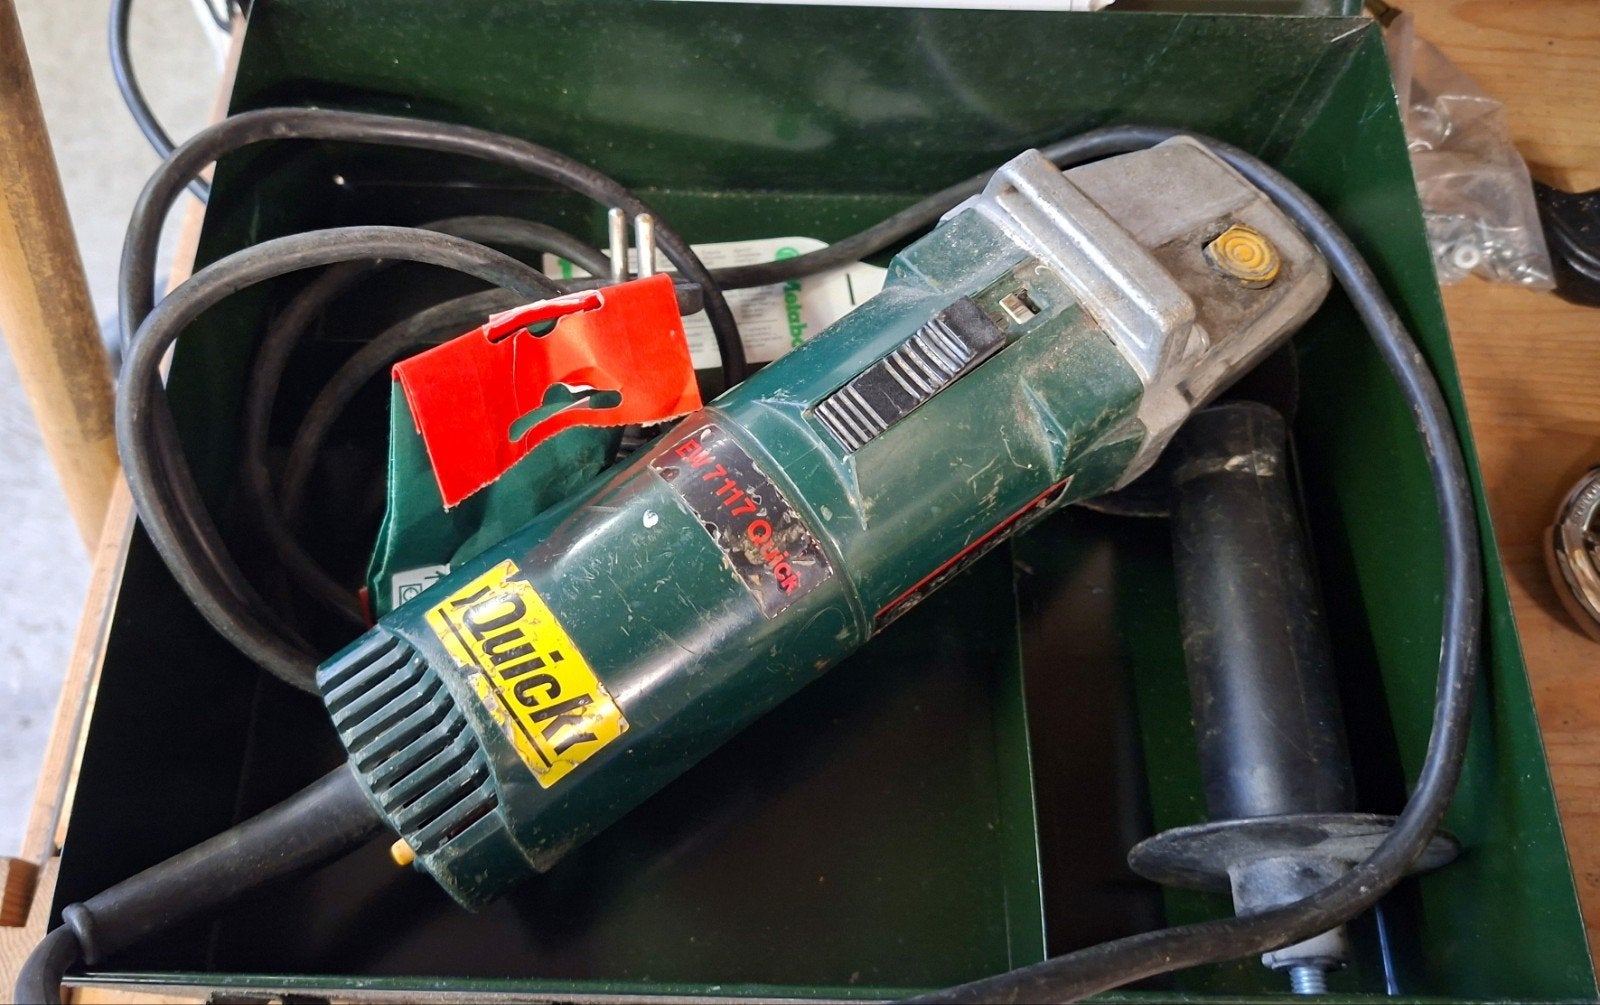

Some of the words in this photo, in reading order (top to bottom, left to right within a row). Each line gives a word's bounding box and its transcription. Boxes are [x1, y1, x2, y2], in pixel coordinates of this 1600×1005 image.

[703, 464, 758, 517] 7117
[747, 519, 802, 597] Quick
[460, 590, 597, 755] Quick
